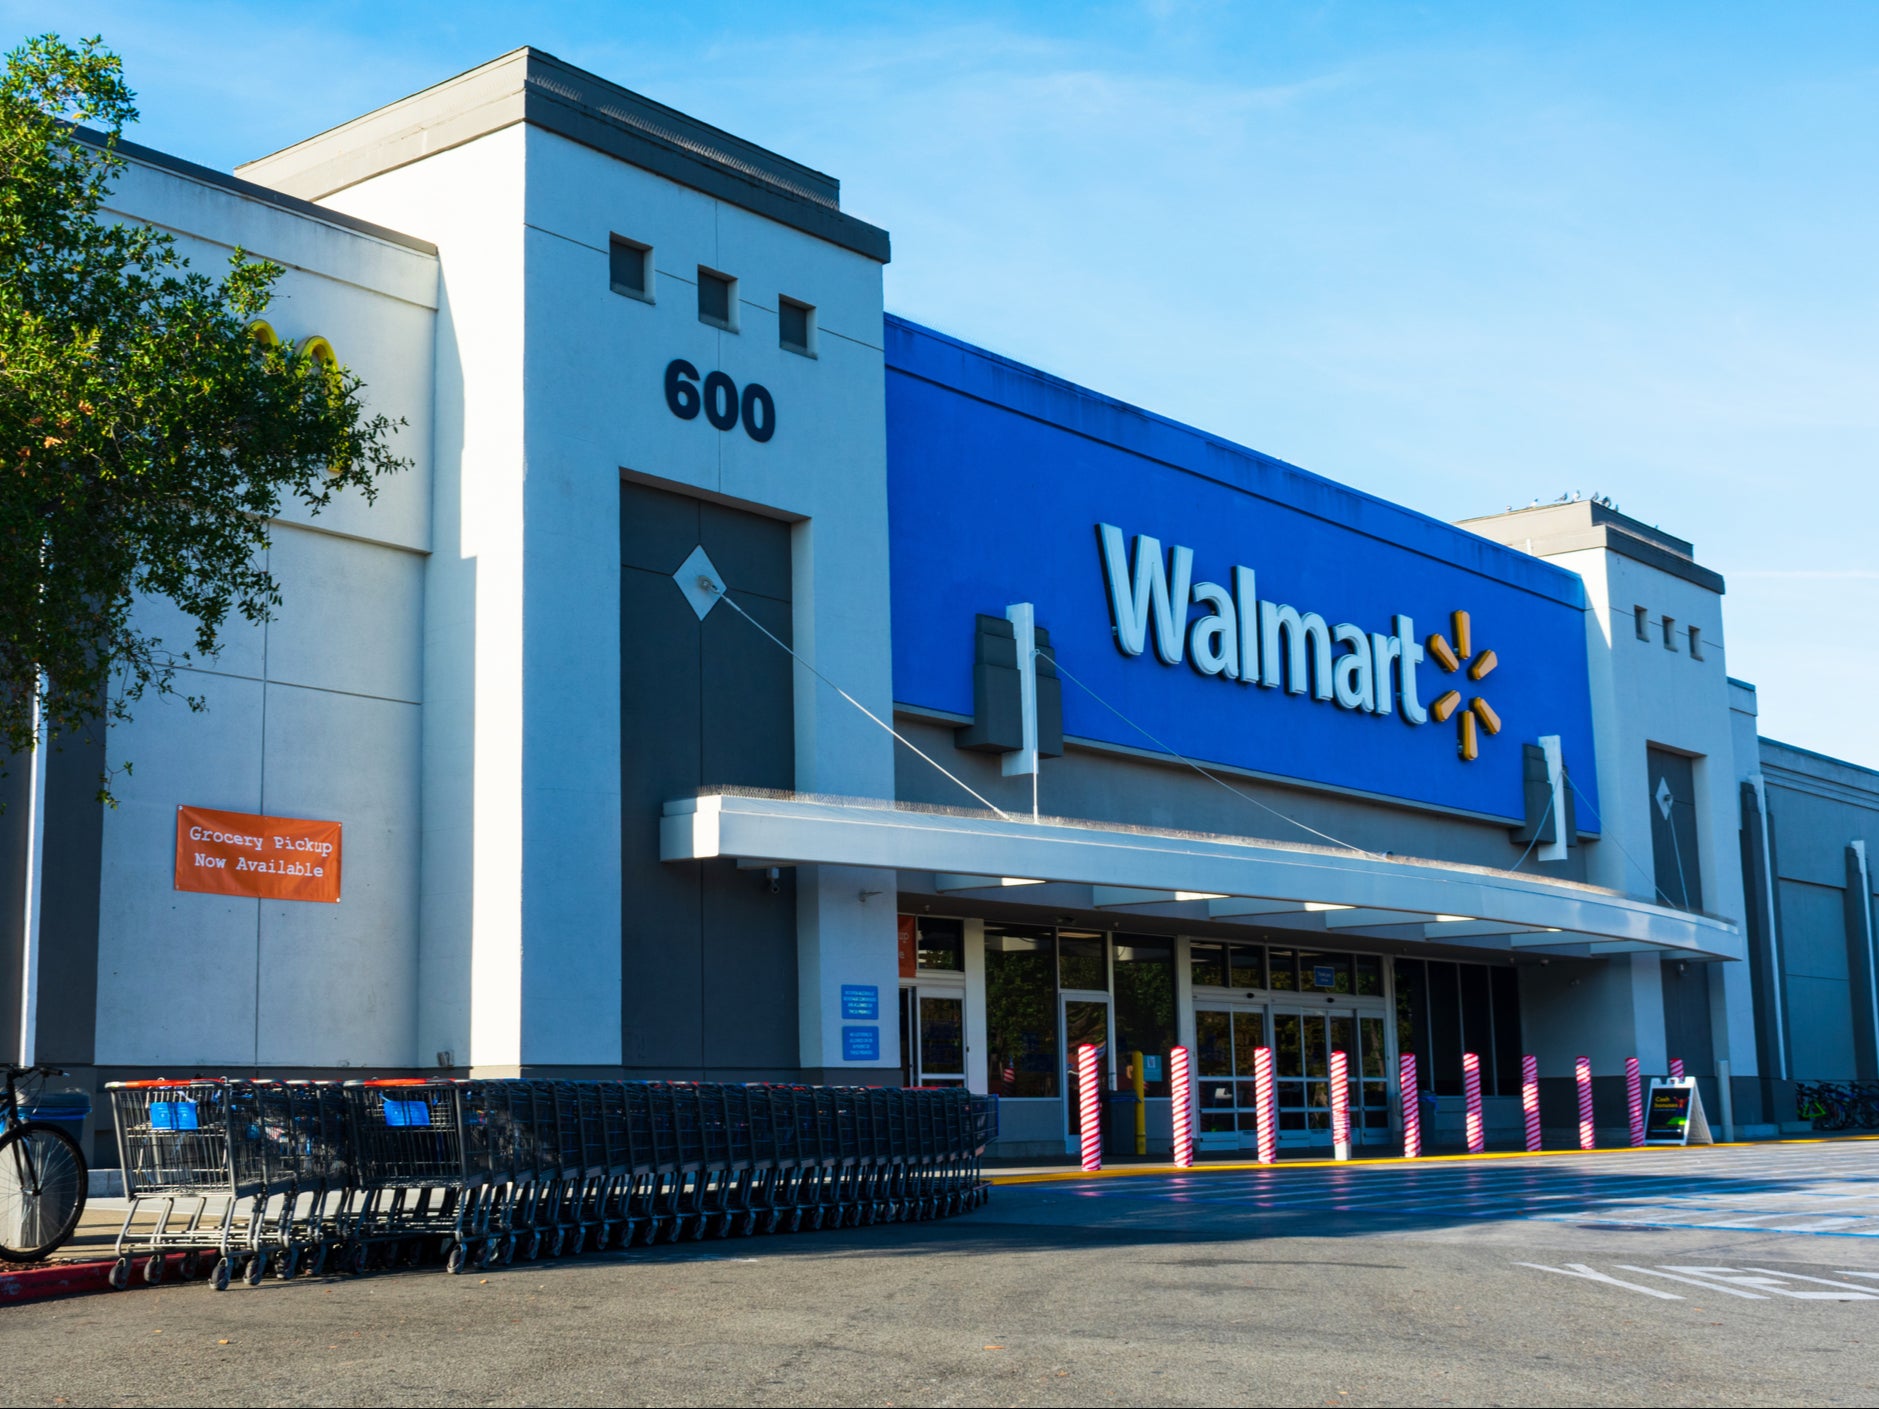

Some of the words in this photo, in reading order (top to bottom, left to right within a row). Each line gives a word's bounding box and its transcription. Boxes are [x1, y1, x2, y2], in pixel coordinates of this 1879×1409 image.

[664, 359, 775, 443] 600
[1097, 522, 1428, 726] Walmart
[189, 826, 264, 851] Grocery
[273, 836, 333, 857] Pickup
[194, 853, 227, 869] Now
[235, 857, 324, 877] Available
